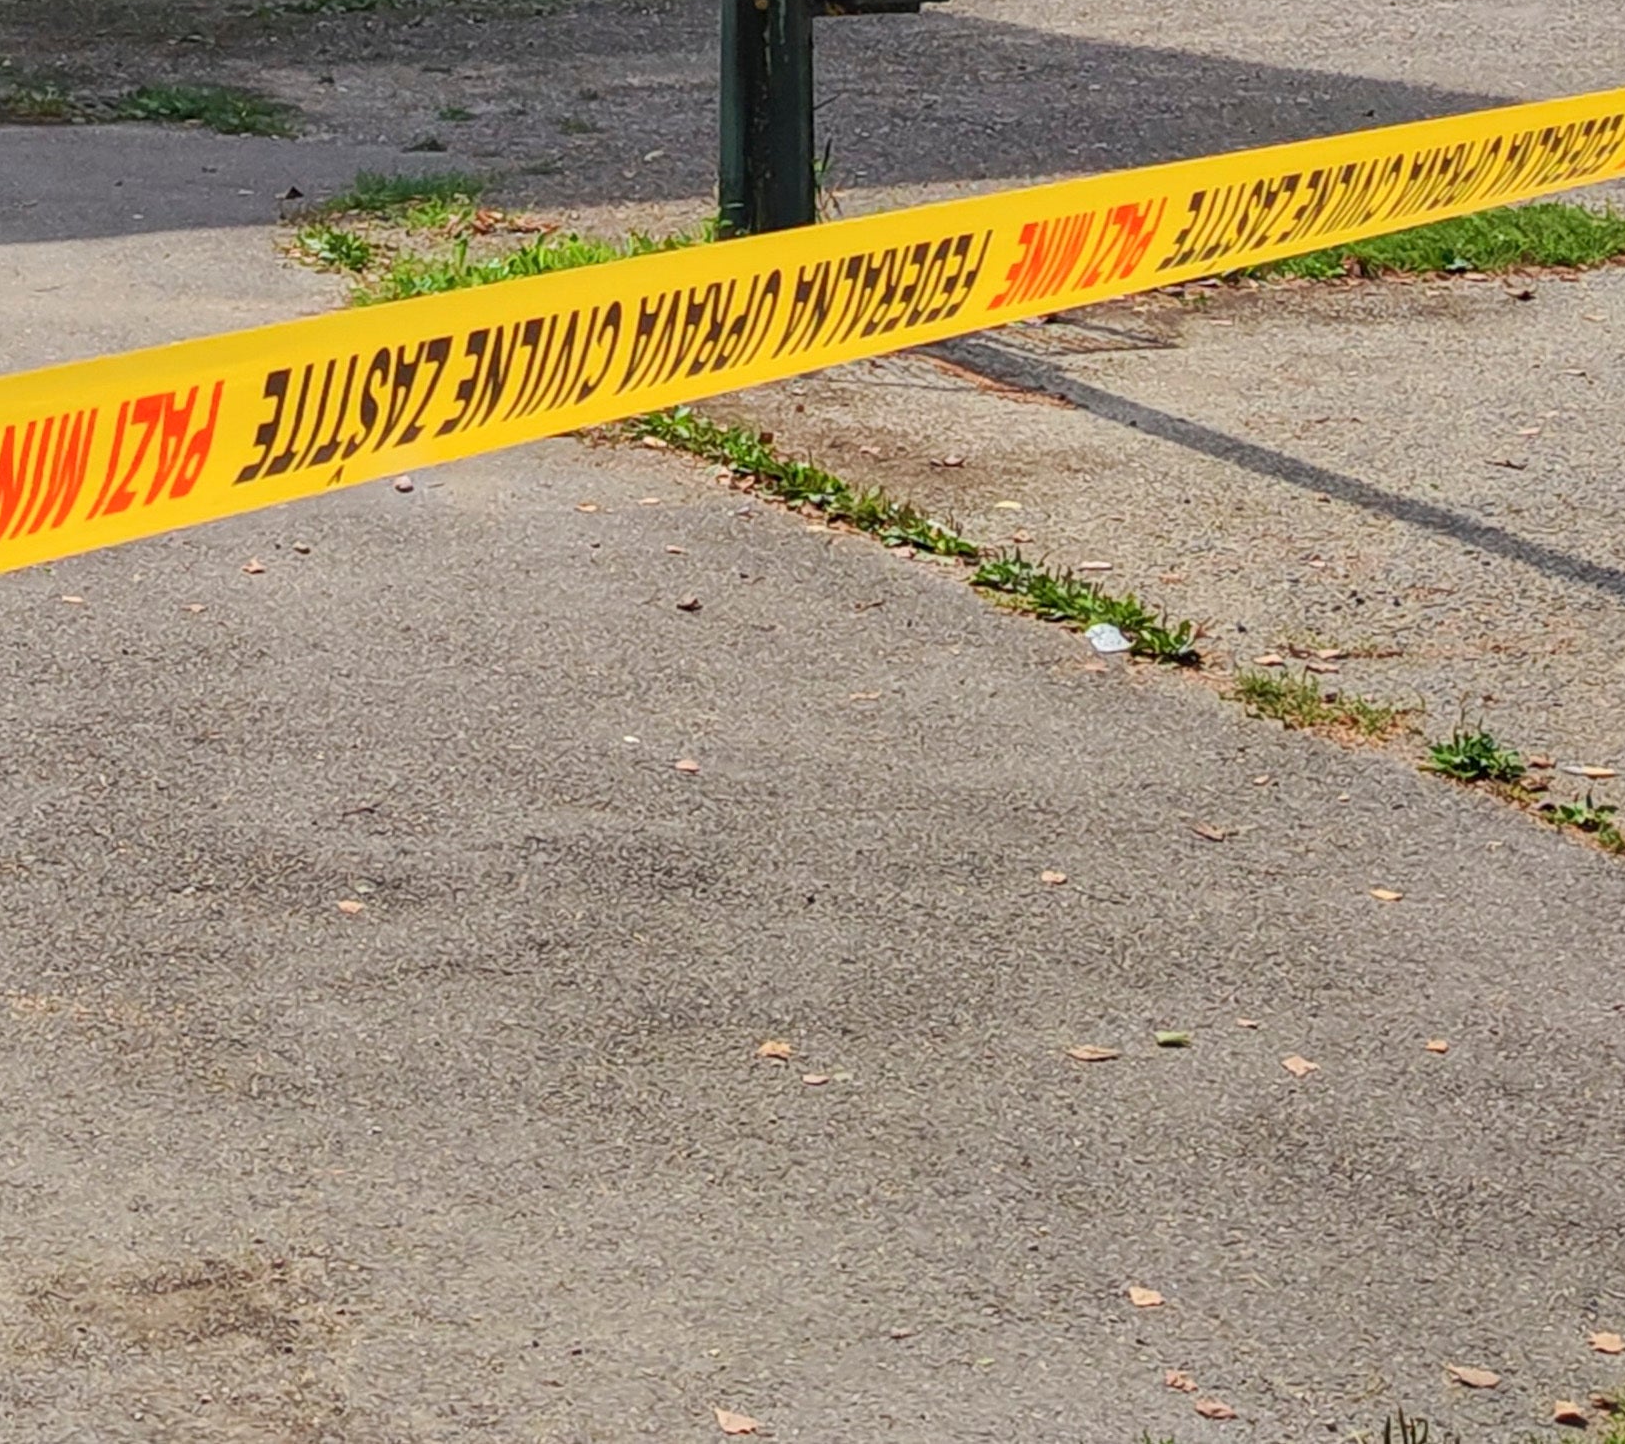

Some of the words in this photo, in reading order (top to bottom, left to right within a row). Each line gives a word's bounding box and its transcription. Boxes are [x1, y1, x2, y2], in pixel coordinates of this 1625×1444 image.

[772, 229, 993, 359] FEDERALNA
[986, 212, 1096, 311] MINE
[1080, 198, 1168, 291] PAZI
[434, 300, 623, 438] CIVILNE
[616, 268, 781, 393] UPRAVA
[86, 380, 225, 521] PAZI
[232, 336, 453, 486] ZAŠTITE
